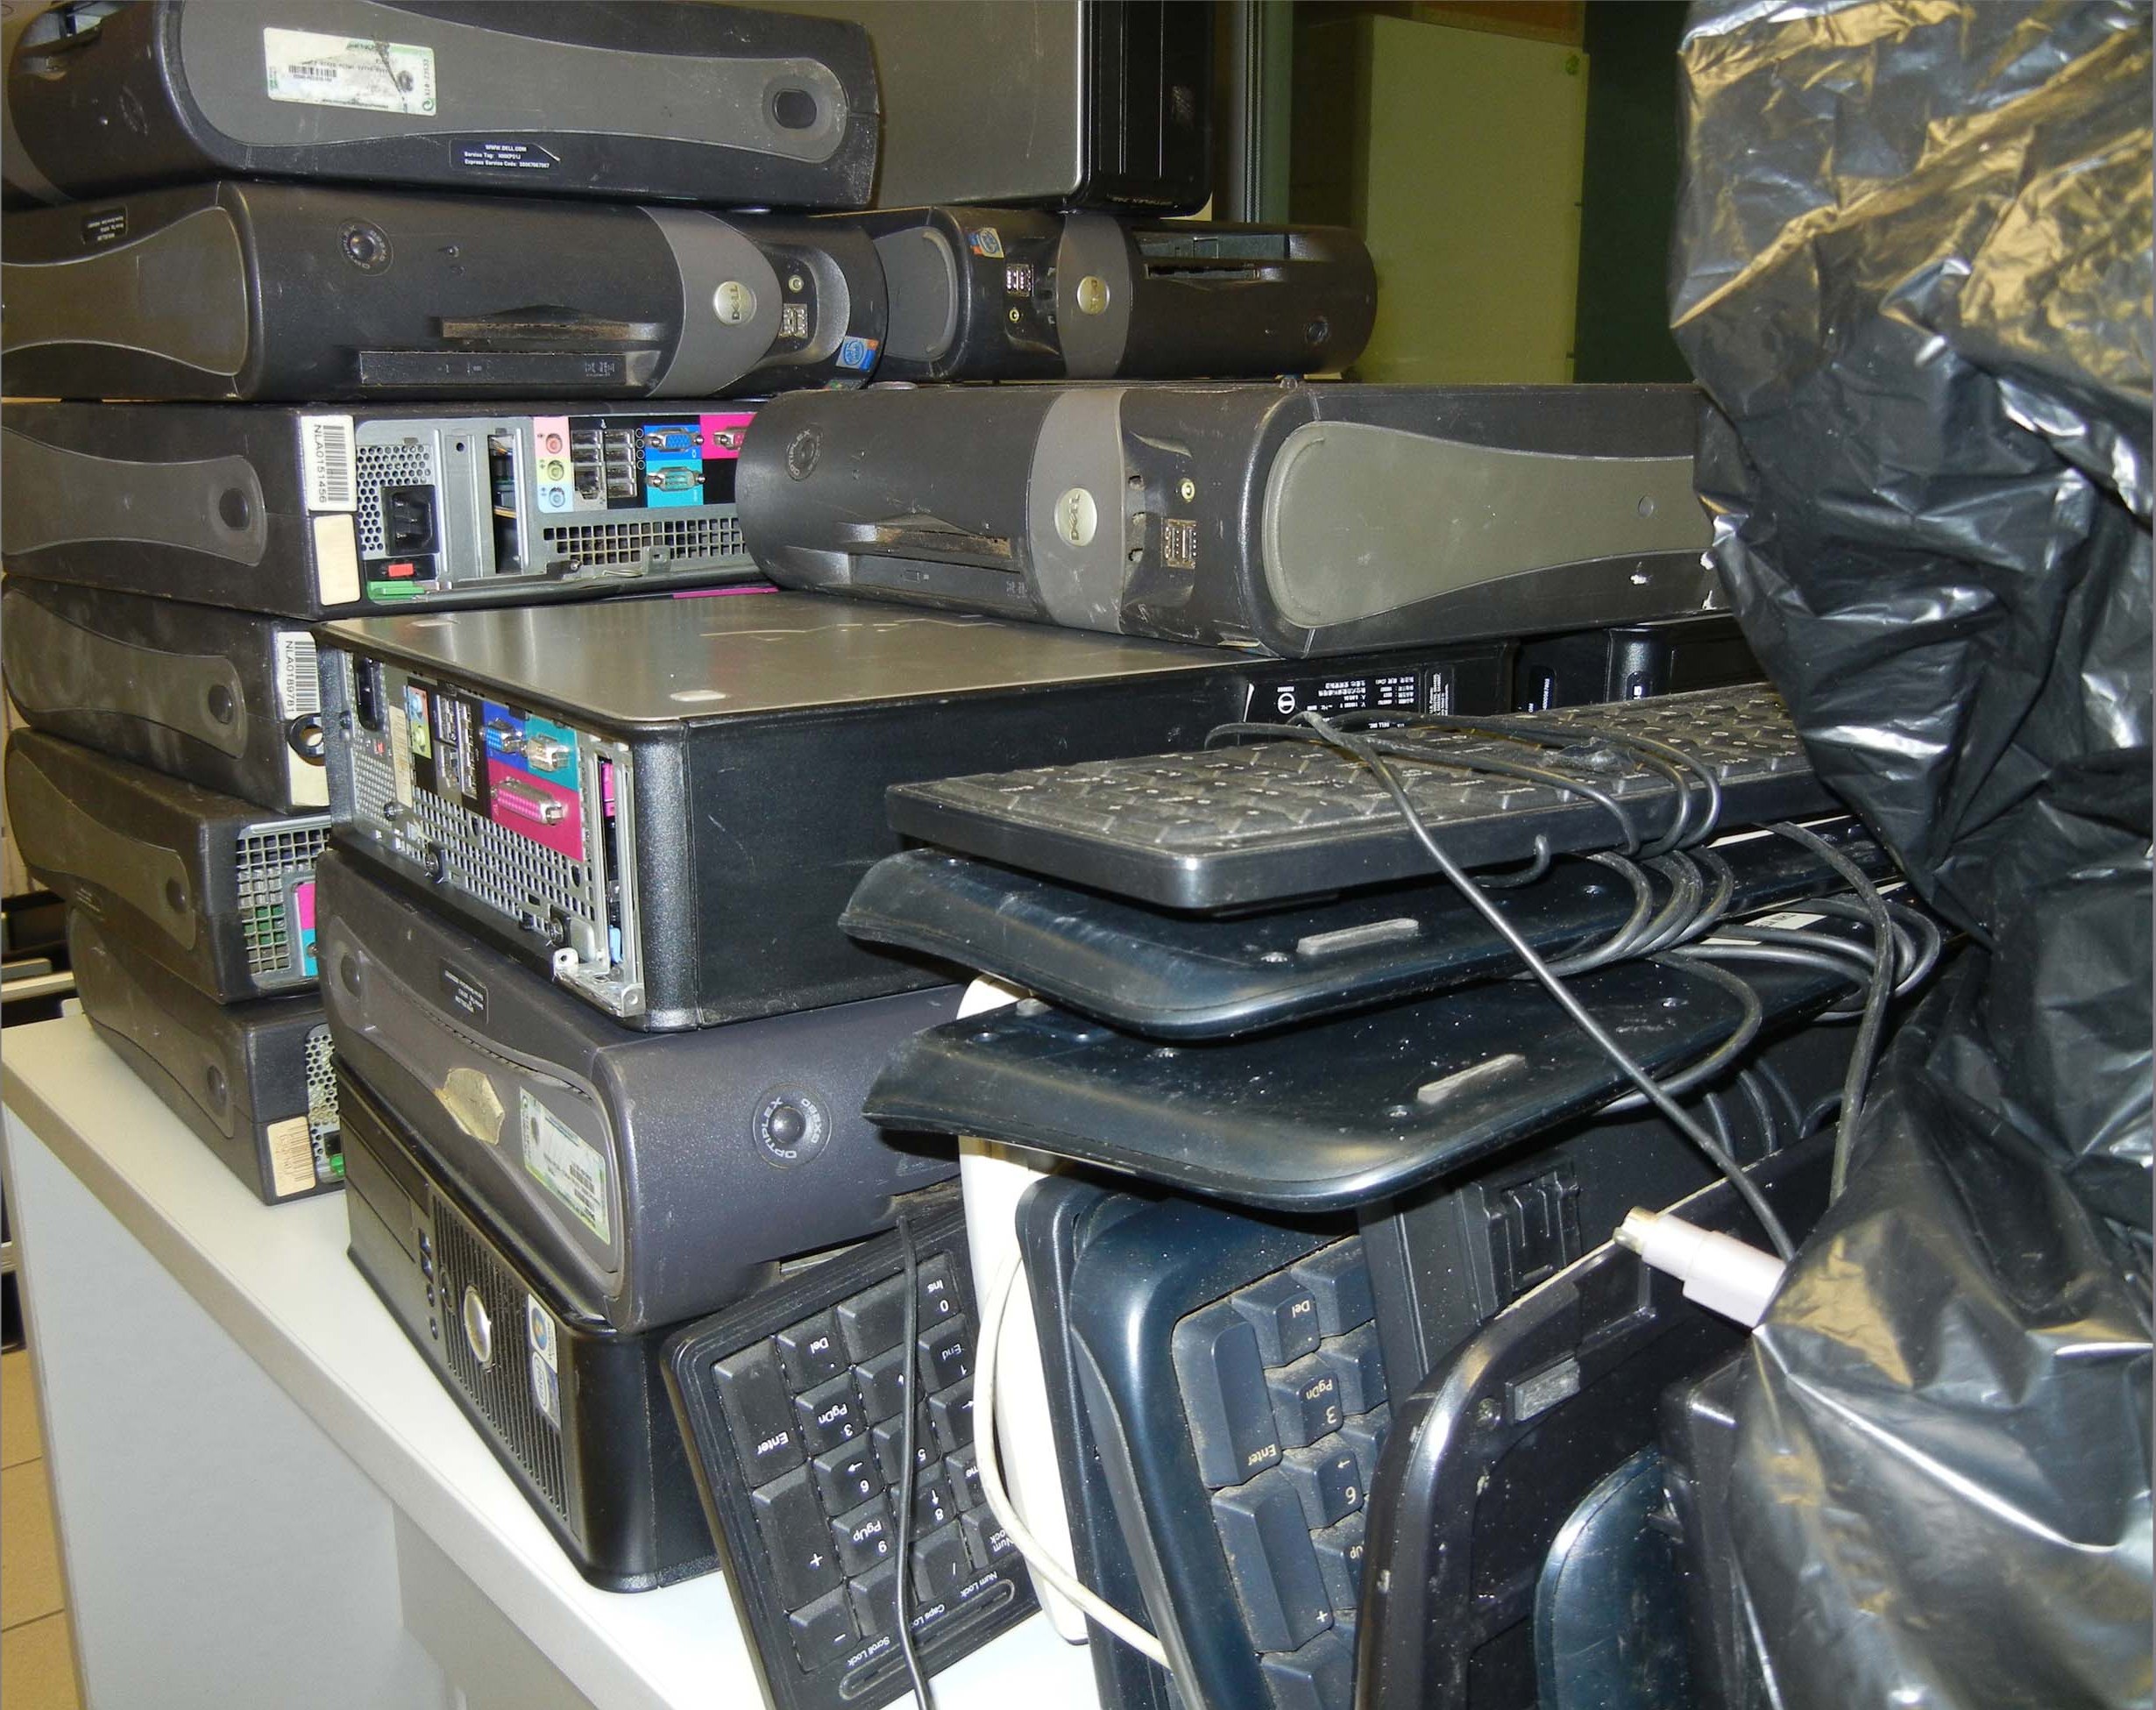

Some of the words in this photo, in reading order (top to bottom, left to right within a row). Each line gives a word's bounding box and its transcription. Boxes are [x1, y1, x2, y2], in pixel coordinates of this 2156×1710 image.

[314, 424, 327, 503] NLA0151456
[762, 1096, 798, 1159] OPTIPLEX
[927, 1279, 944, 1293] Ins
[1291, 1300, 1311, 1318] Del
[810, 1337, 829, 1354] Del
[941, 1343, 962, 1361] End
[1306, 1378, 1333, 1401] PgDn
[818, 1403, 848, 1424] PgDn
[1326, 1405, 1337, 1424] 3
[843, 1423, 854, 1437] 3
[756, 1430, 790, 1455] Enter
[918, 1448, 926, 1461] 5
[1247, 1444, 1277, 1466] Enter
[934, 1508, 944, 1521] 8
[852, 1520, 883, 1542] PgUp
[989, 1529, 1006, 1544] ock
[976, 1571, 998, 1587] Num
[960, 1583, 978, 1598] Lock
[924, 1603, 946, 1621] Caps
[867, 1635, 890, 1656] Scroll
[847, 1652, 868, 1667] Lock
